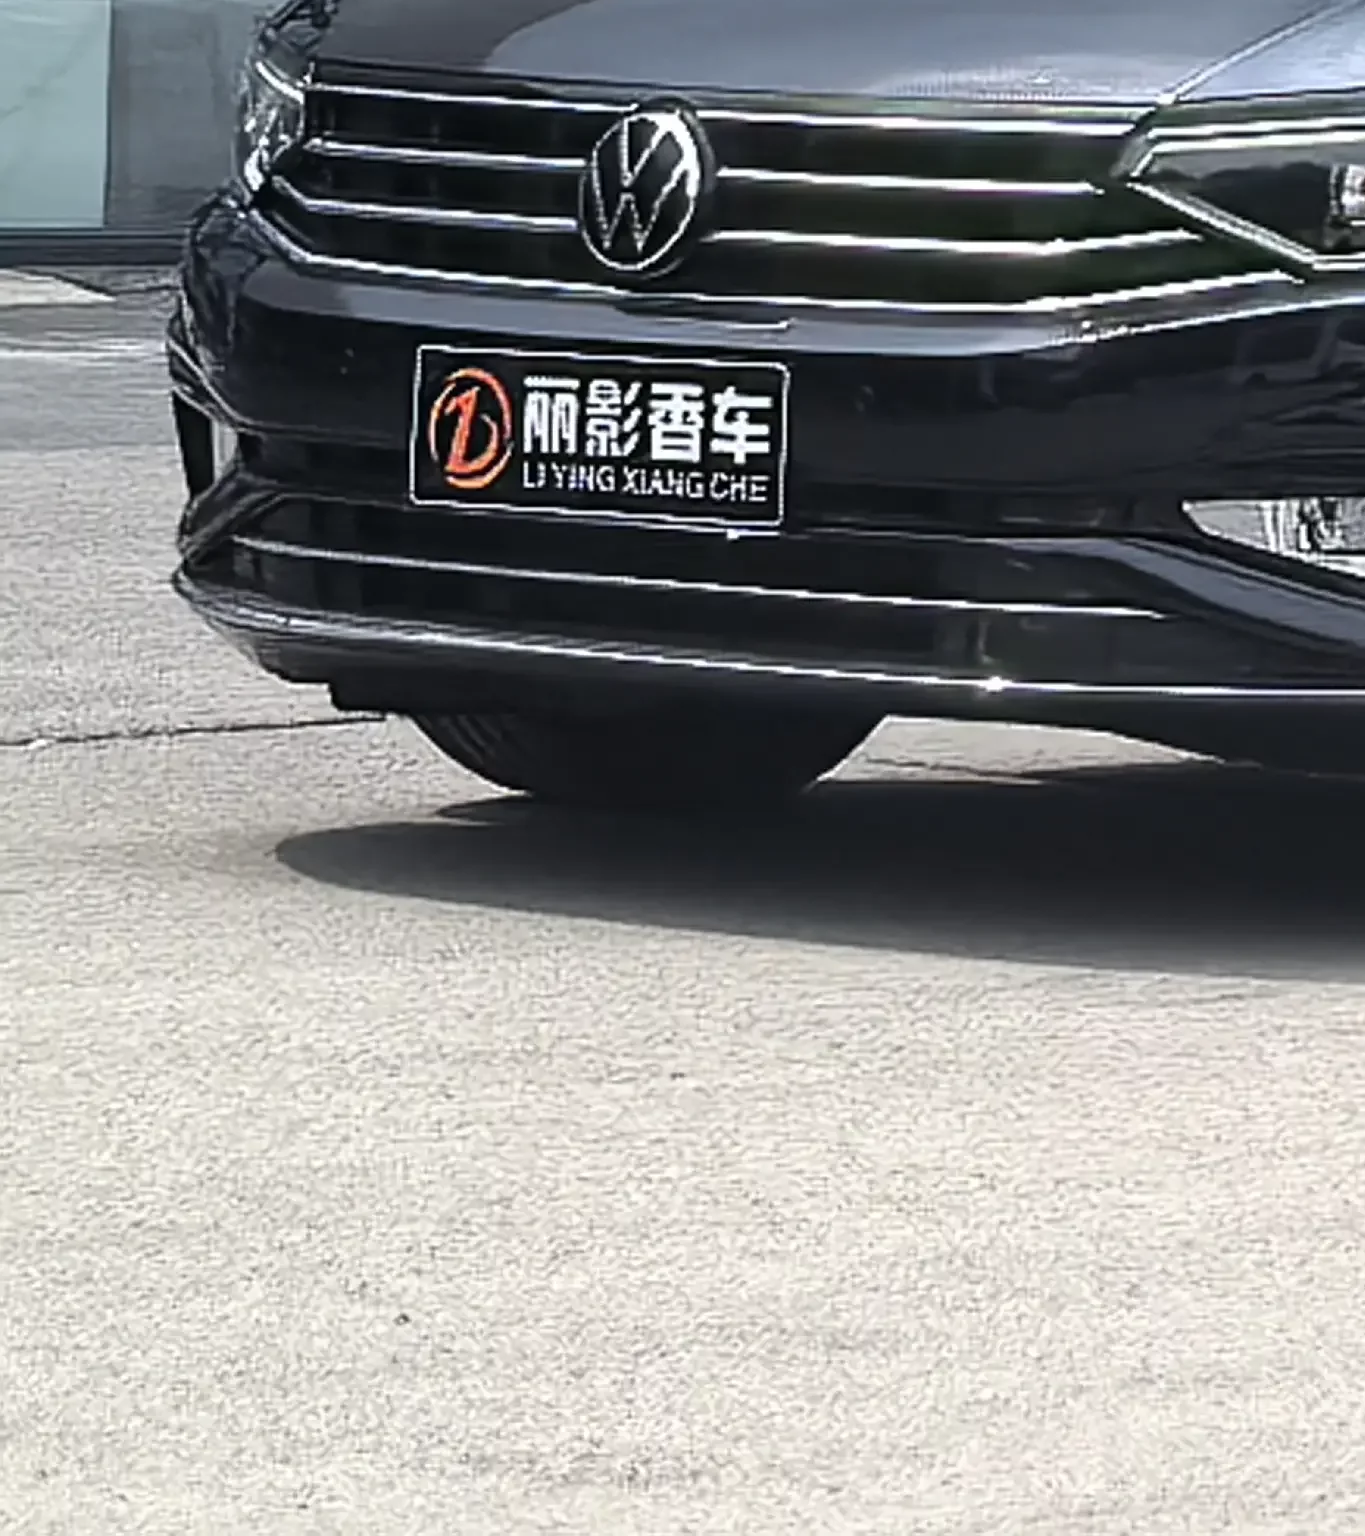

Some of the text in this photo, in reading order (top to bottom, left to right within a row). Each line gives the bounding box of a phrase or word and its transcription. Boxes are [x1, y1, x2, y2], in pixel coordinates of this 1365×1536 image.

[522, 375, 775, 465] 丽影香车
[550, 461, 616, 493] YING
[622, 464, 705, 500] XIANG
[709, 471, 771, 502] CHE
